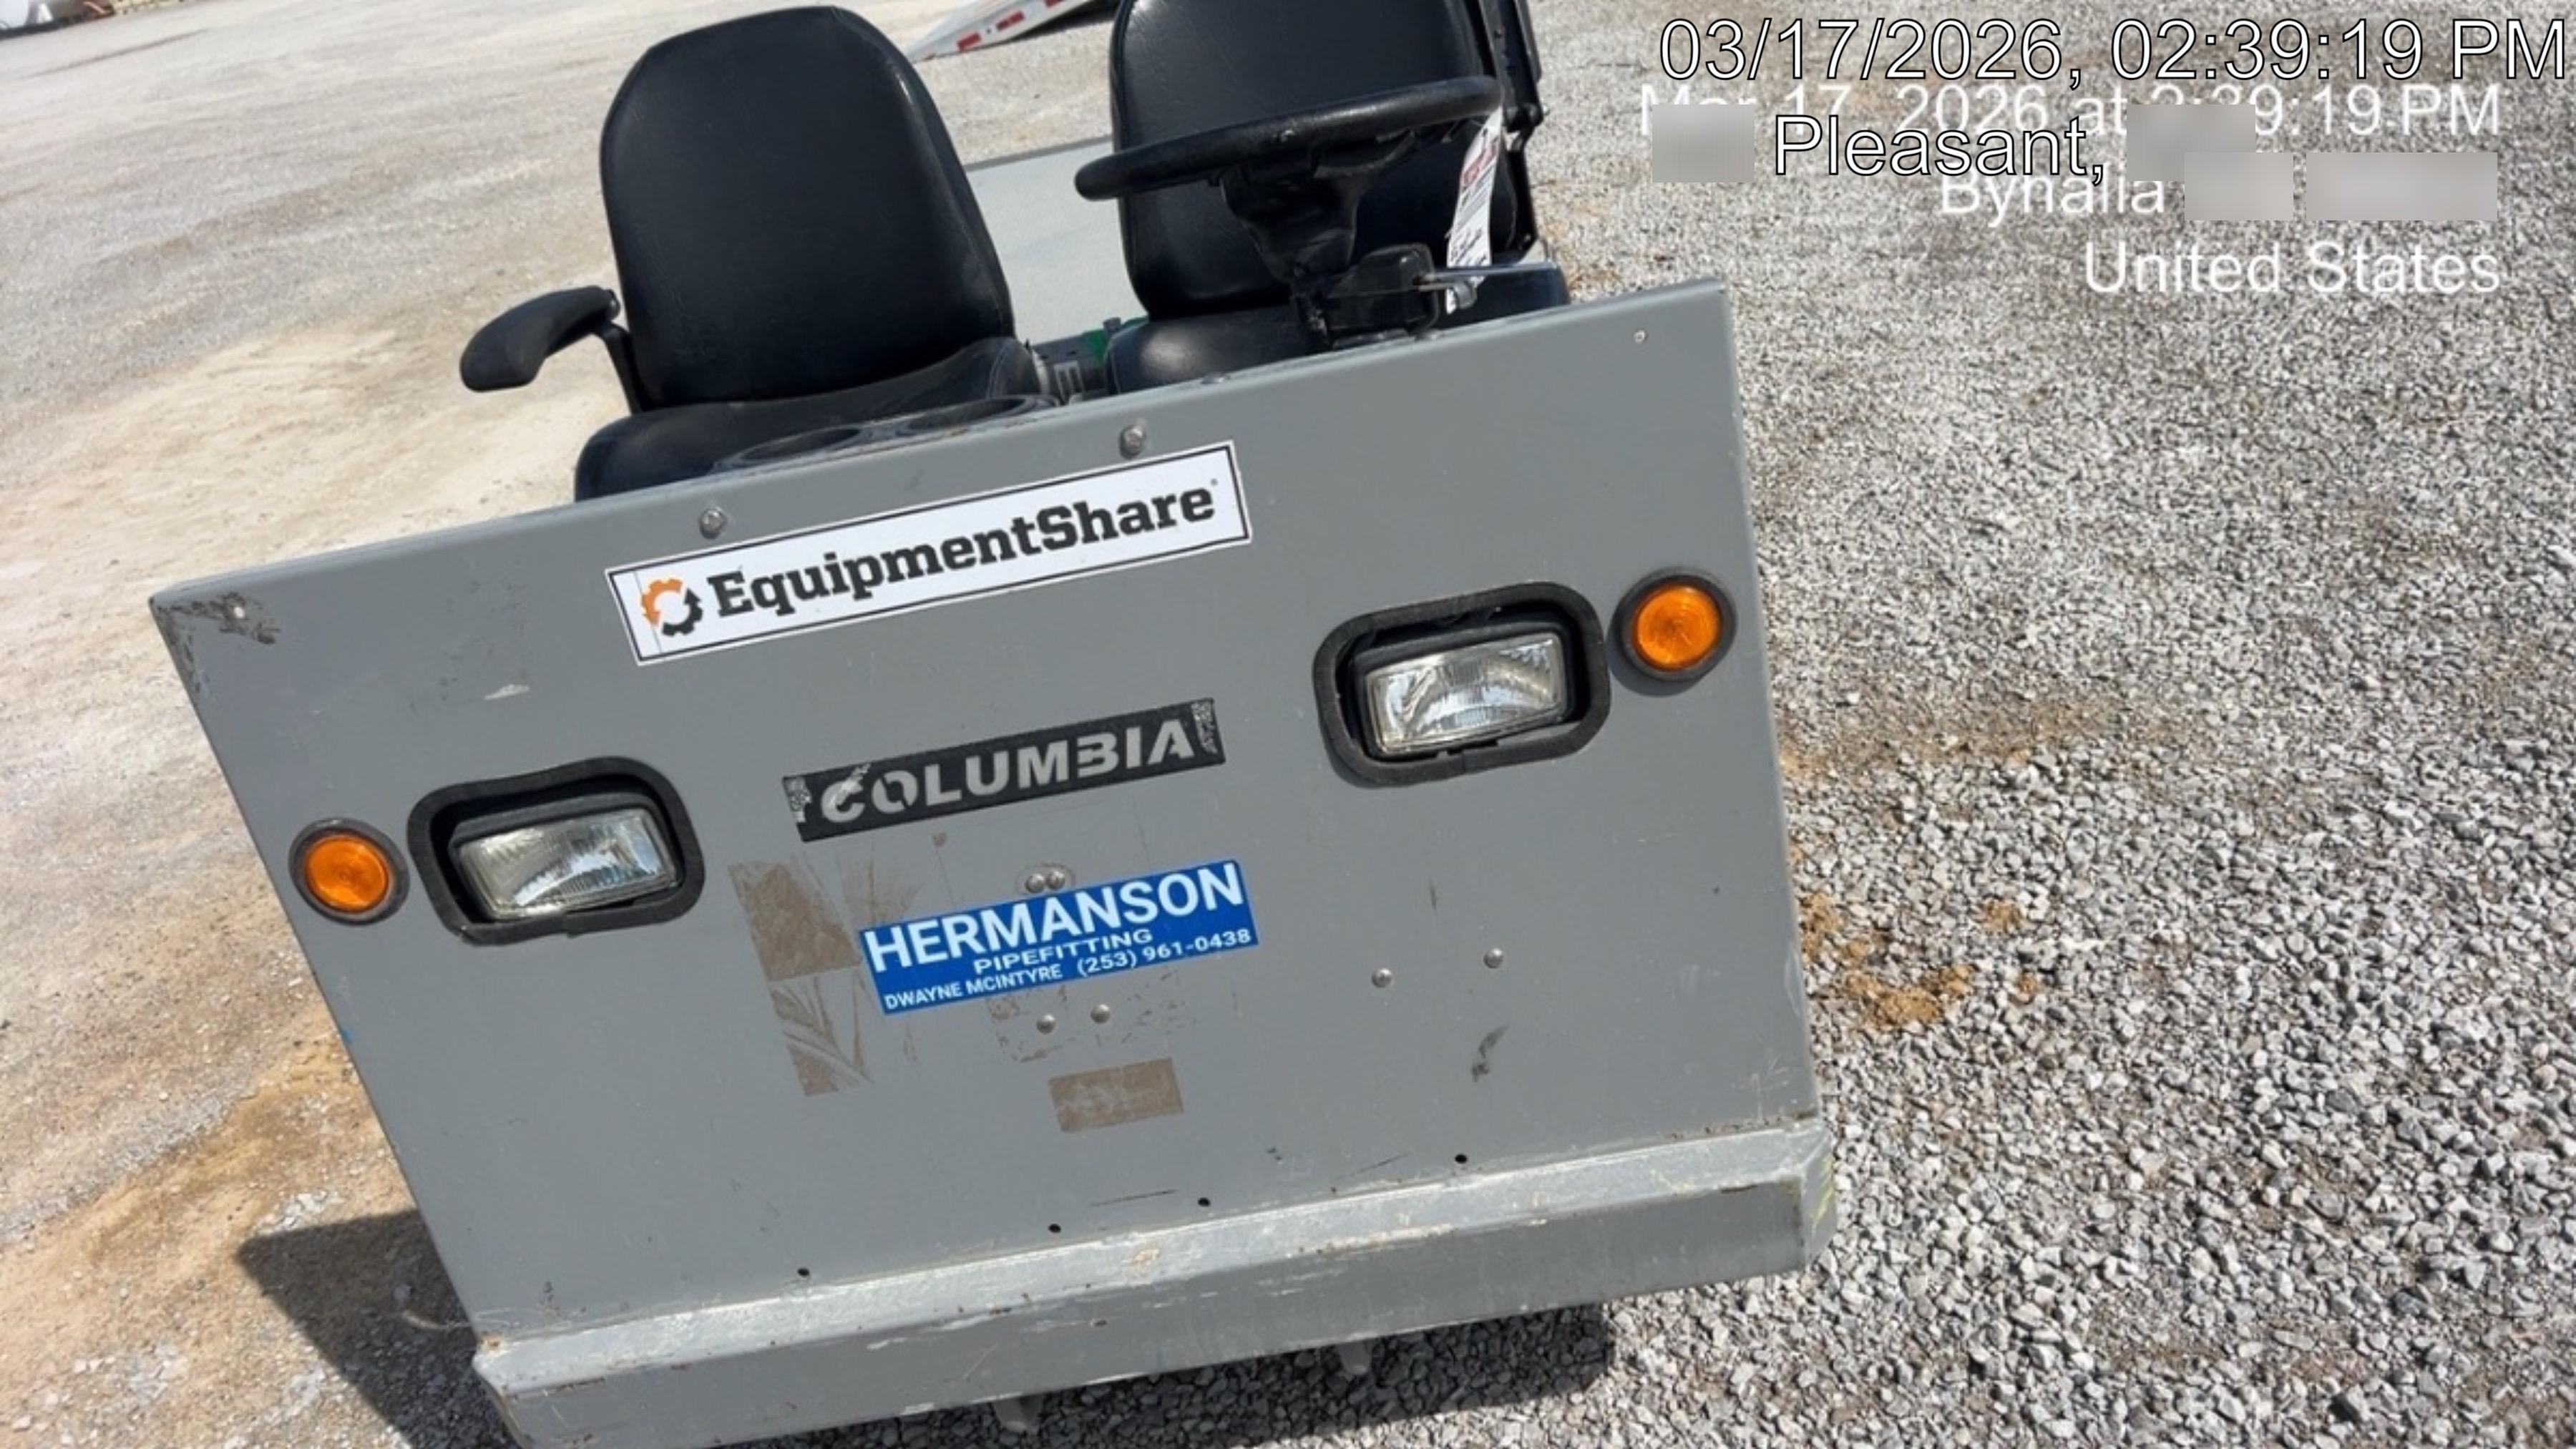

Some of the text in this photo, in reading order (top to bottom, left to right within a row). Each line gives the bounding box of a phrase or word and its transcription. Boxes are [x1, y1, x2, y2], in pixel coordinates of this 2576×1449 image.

[707, 488, 1215, 618] EquipmentShare
[820, 718, 1195, 824] COLUMBIA
[864, 862, 1243, 973] HERMANSON
[884, 929, 1252, 1010] DWAYNE MCINTYRE (253) 961-0438
[973, 928, 1154, 975] PIPEFITTING
